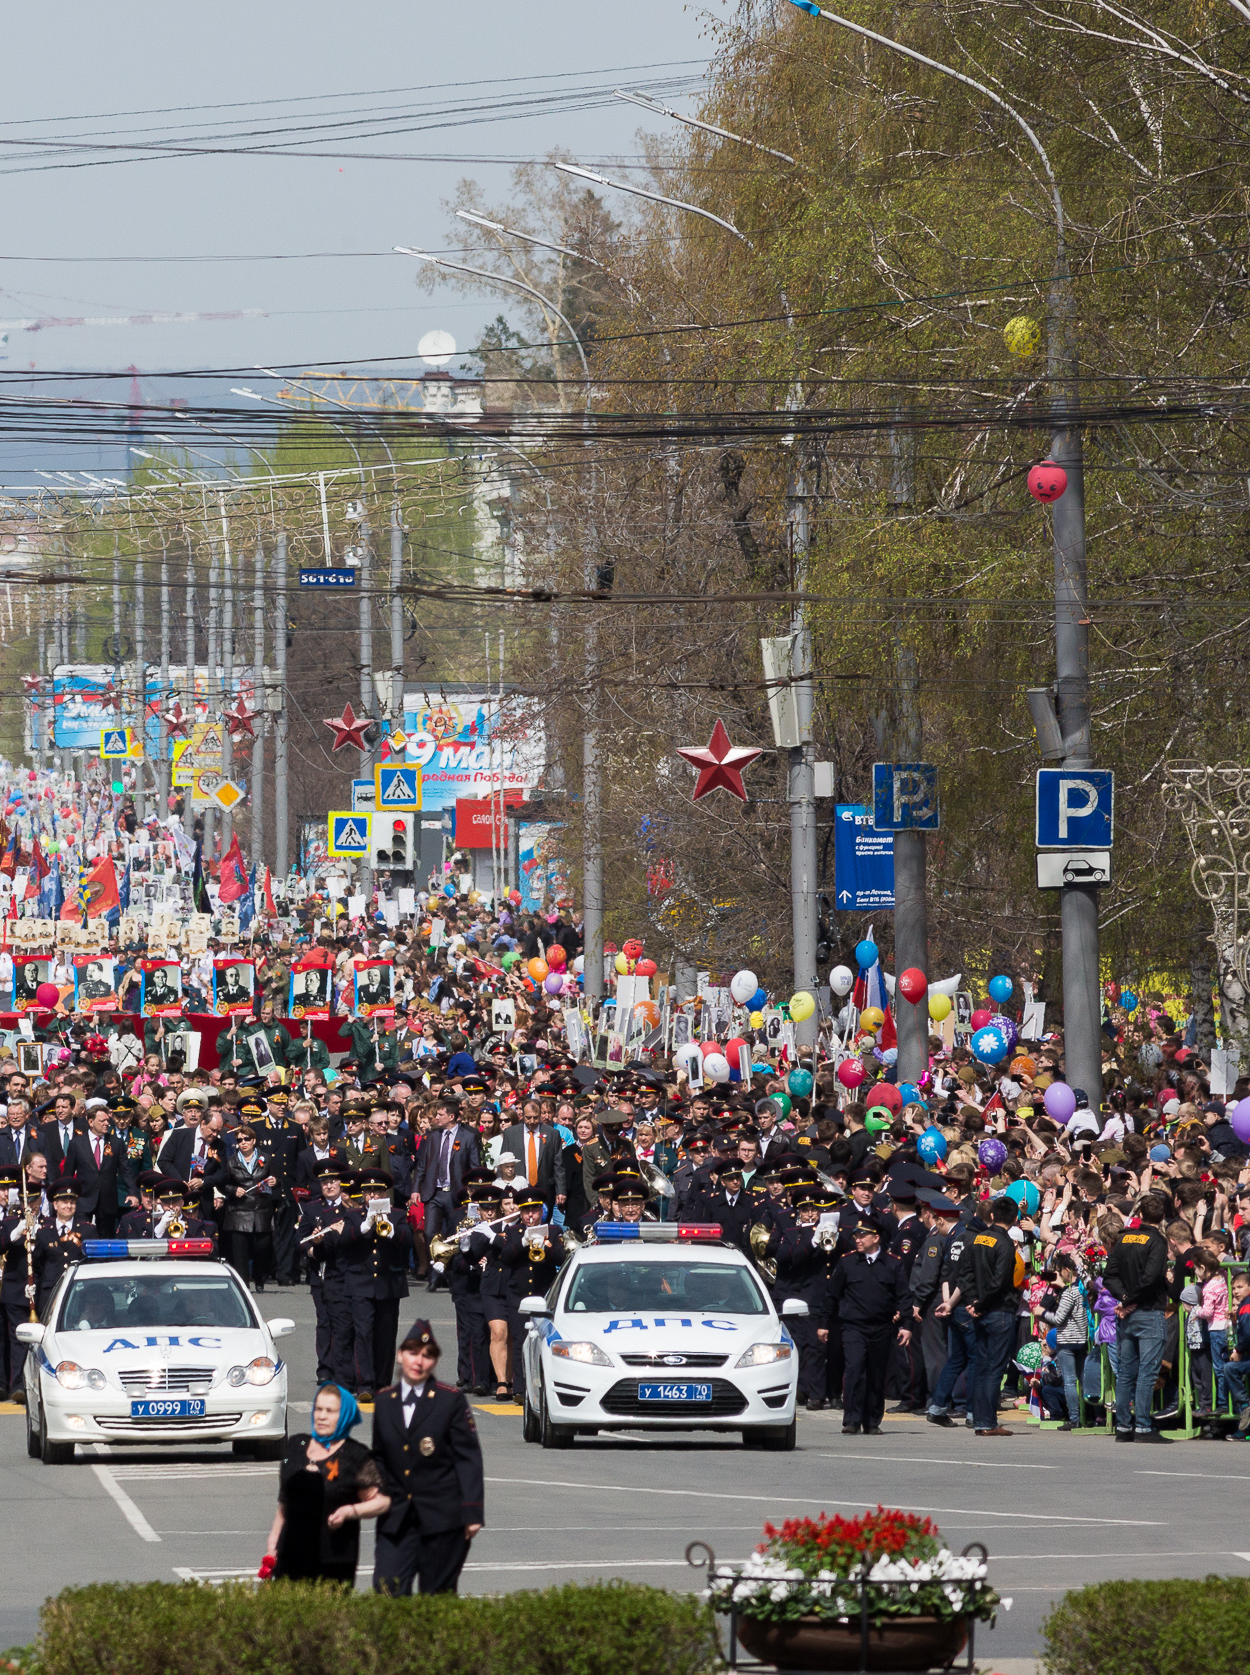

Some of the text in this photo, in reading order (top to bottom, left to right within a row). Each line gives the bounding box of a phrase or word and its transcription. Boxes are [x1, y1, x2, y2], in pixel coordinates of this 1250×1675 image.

[406, 732, 437, 765] 9
[422, 773, 471, 785] родная
[893, 771, 927, 822] P
[1059, 779, 1099, 838] P
[855, 836, 894, 844] Банкомат
[603, 1318, 739, 1334] ДПС
[657, 1385, 688, 1399] 1463
[695, 1385, 708, 1395] 70
[149, 1401, 181, 1415] 0999
[188, 1400, 201, 1410] 70
